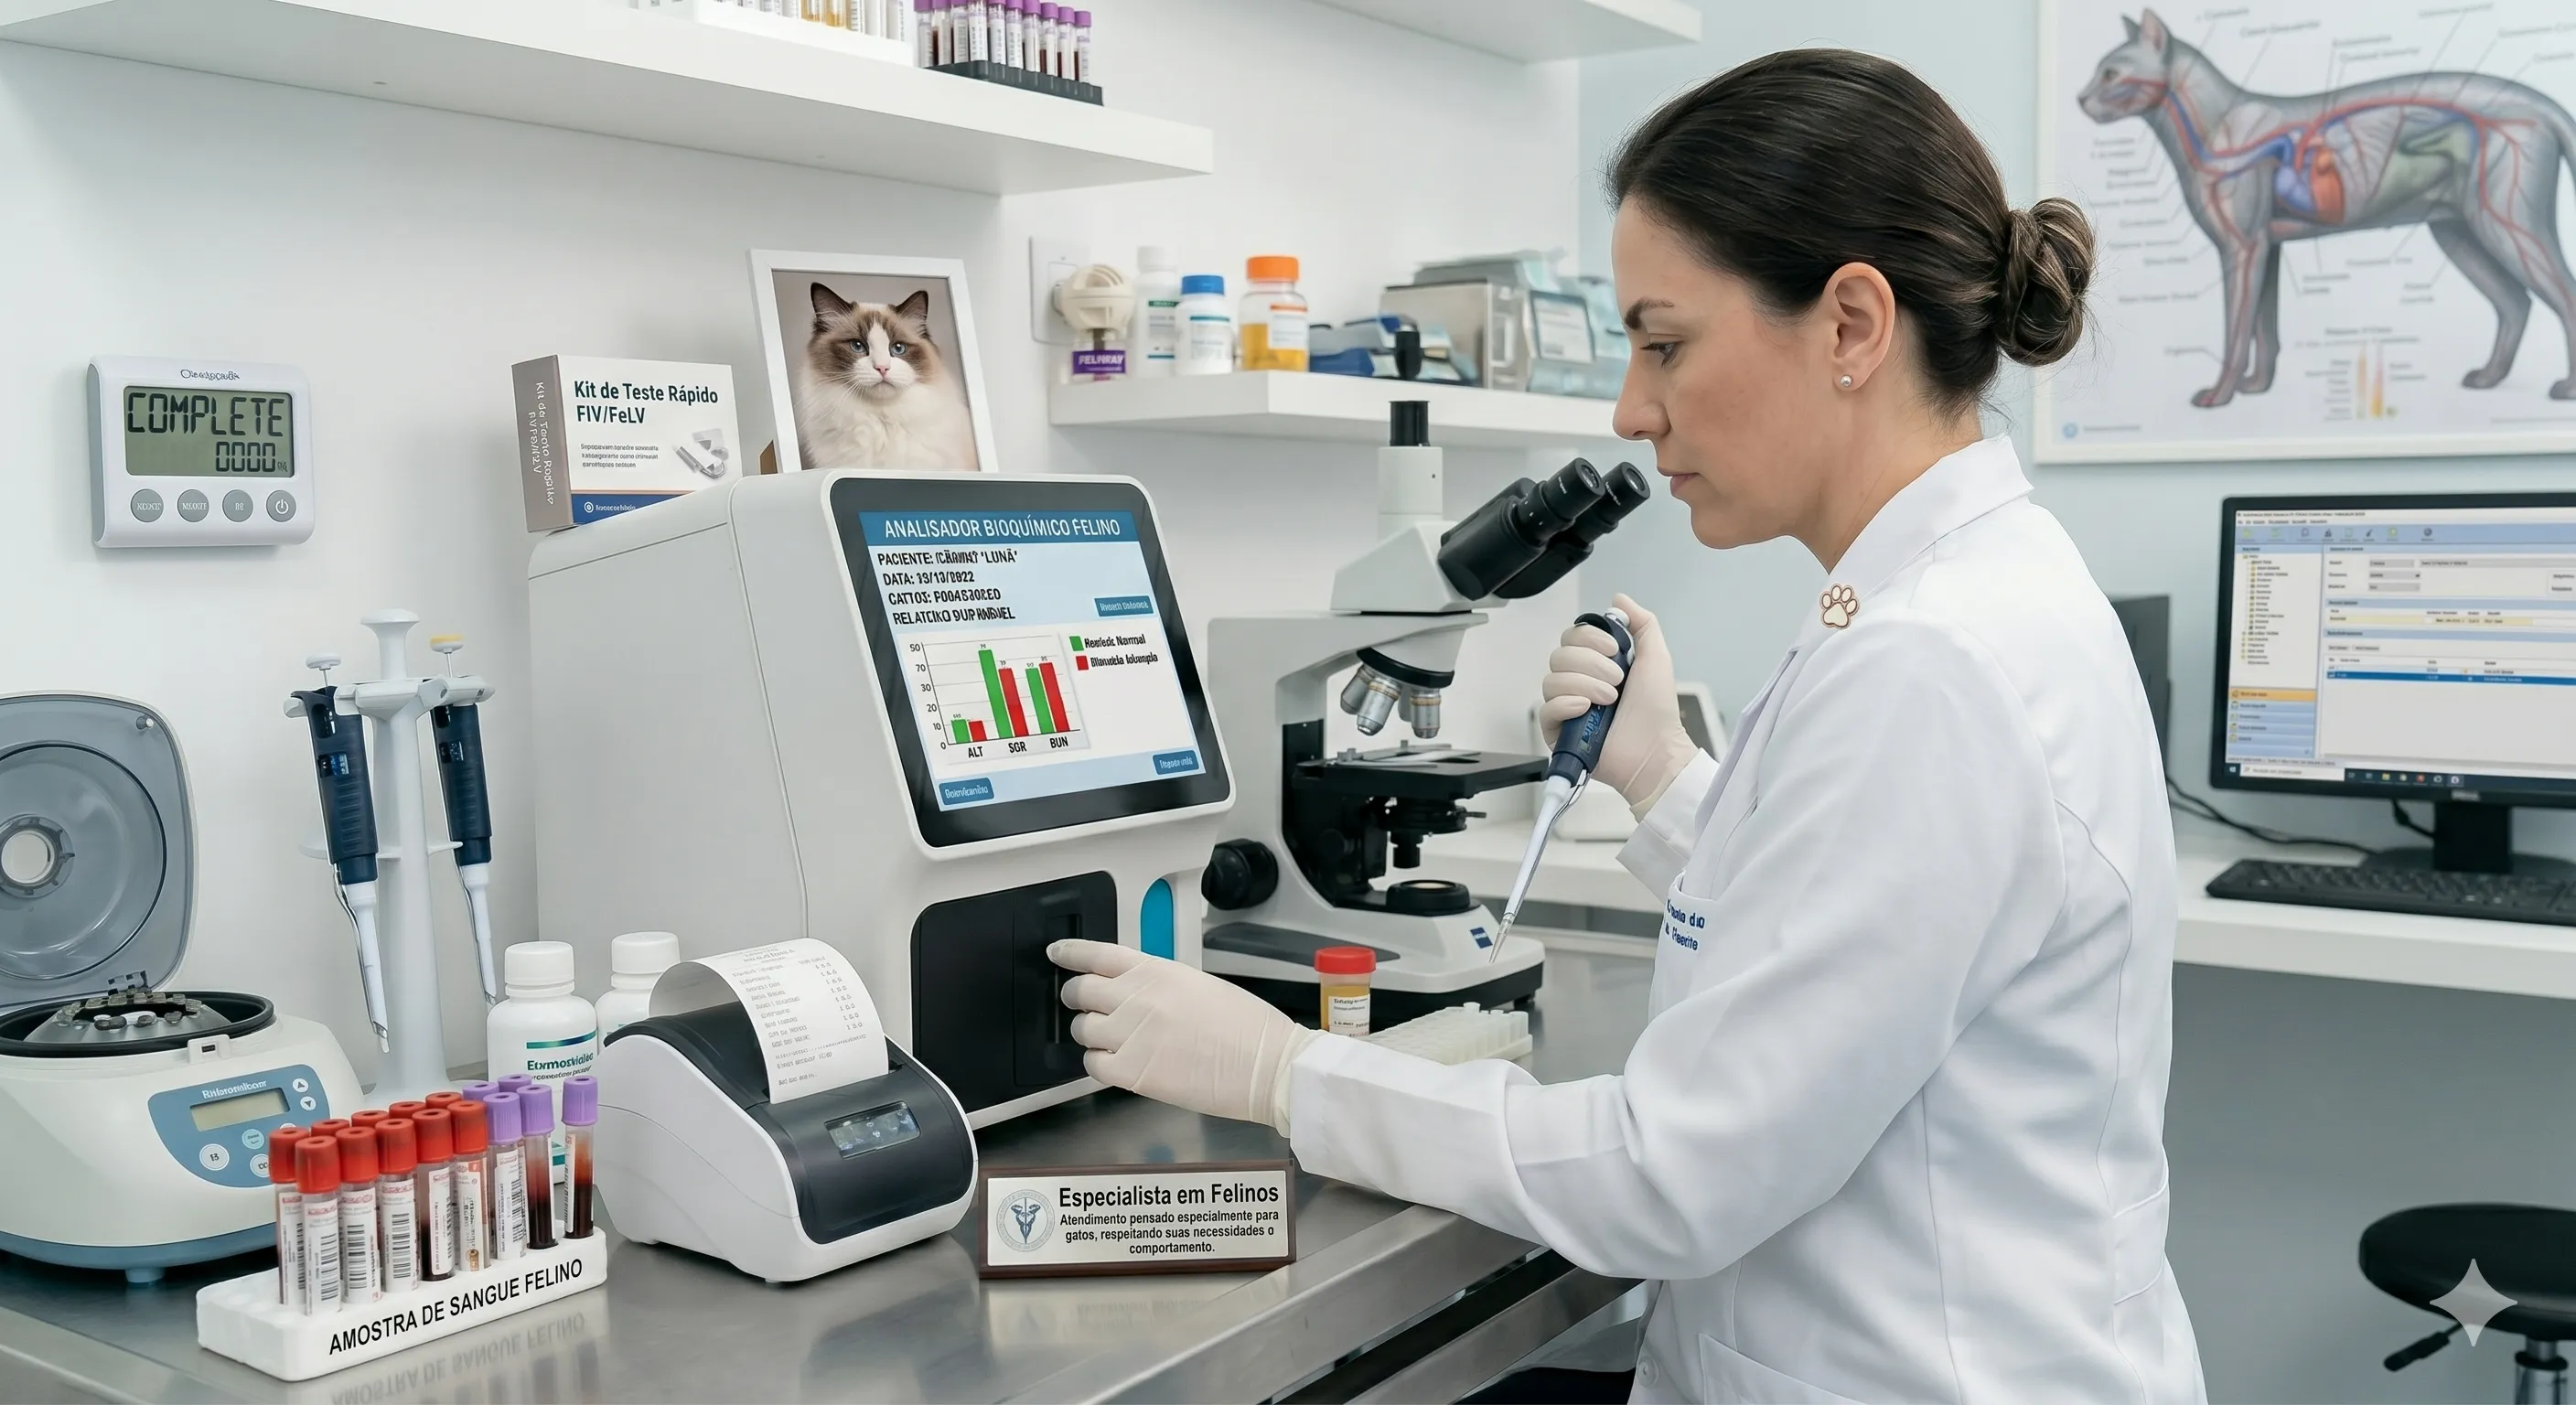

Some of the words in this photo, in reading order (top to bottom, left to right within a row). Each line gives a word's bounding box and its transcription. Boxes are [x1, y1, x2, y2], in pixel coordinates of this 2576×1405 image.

[574, 381, 597, 399] Kit
[600, 381, 619, 400] de
[622, 383, 664, 401] Teste
[668, 385, 718, 406] Rápido
[127, 391, 284, 437] COMPLETE
[576, 405, 646, 424] FIV/FeLV
[215, 441, 276, 473] 0000
[886, 519, 982, 538] ANALISADOR
[982, 514, 1070, 538] BIOQUÍMICO
[877, 552, 934, 565] PACIENTE:
[883, 573, 915, 585] DATA:
[915, 664, 926, 672] 70
[920, 683, 931, 692] 30
[927, 703, 938, 713] 20
[933, 723, 941, 731] 10
[968, 746, 983, 758] ALT
[1008, 741, 1027, 753] SGR
[1049, 736, 1068, 748] BUN
[1059, 1185, 1172, 1211] Especialista
[1177, 1189, 1205, 1204] em
[1211, 1183, 1279, 1203] Felinos
[1059, 1213, 1127, 1226] Atendimento
[1130, 1212, 1175, 1227] pensado
[1177, 1210, 1252, 1225] especialmente
[1256, 1211, 1279, 1223] para
[1066, 1229, 1098, 1244] gatos,
[1100, 1227, 1163, 1242] respeitando
[1165, 1228, 1190, 1238] suas
[1193, 1225, 1265, 1238] necessidades
[1129, 1241, 1215, 1256] comportamento.
[329, 1310, 418, 1355] AMOSTRA
[422, 1300, 445, 1325] DE
[450, 1277, 520, 1315] SANGUE
[525, 1259, 583, 1293] FELINO
